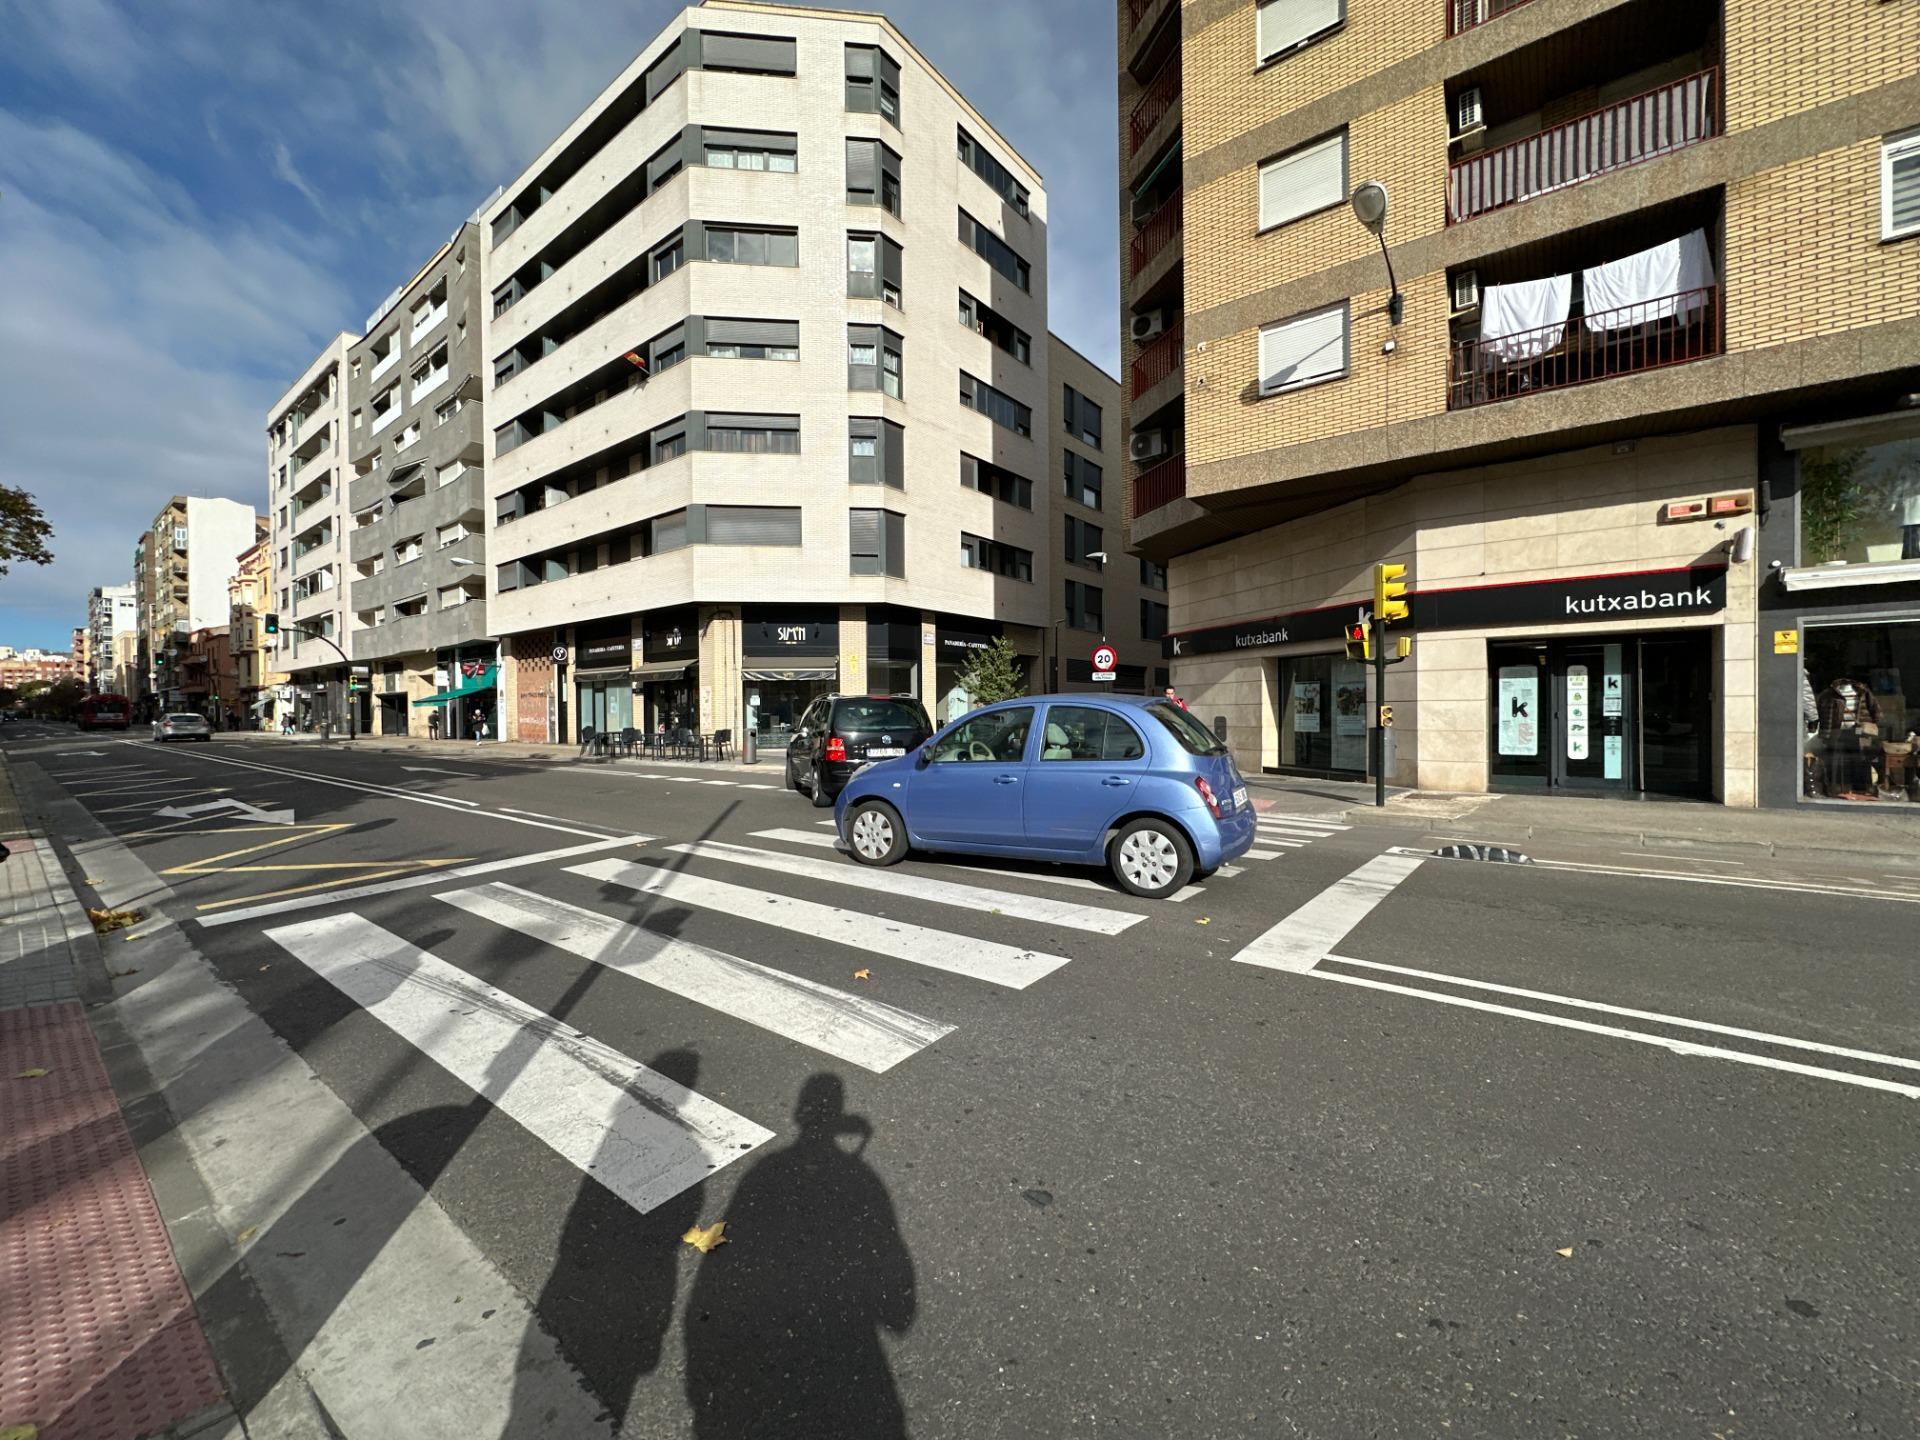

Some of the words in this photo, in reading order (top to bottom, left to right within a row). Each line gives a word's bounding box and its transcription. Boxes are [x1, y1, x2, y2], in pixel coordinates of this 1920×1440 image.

[1565, 586, 1712, 614] kutxabank
[1235, 627, 1289, 648] kutxabank
[1097, 654, 1111, 664] 20
[1512, 697, 1528, 717] k
